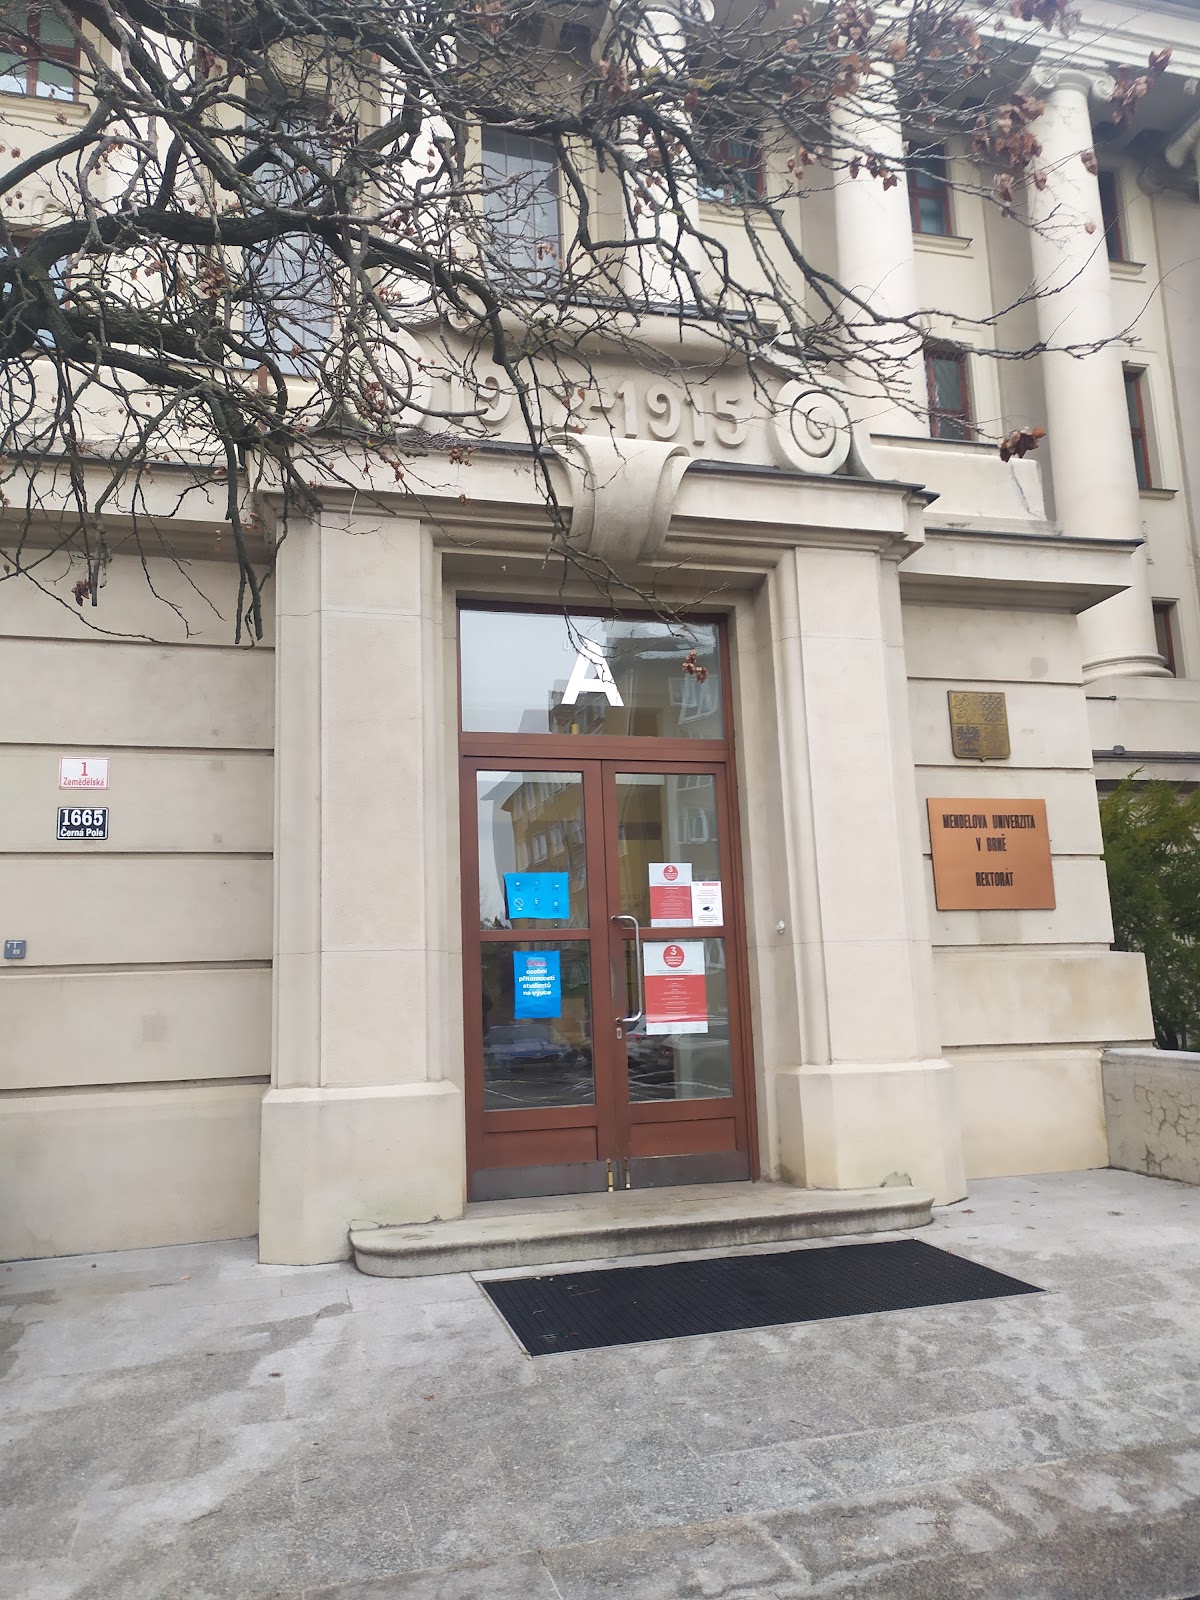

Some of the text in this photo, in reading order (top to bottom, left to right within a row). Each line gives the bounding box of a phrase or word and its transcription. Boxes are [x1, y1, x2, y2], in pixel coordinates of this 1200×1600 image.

[561, 639, 625, 707] A
[81, 762, 88, 776] 1
[63, 777, 105, 786] Zemědělská
[62, 809, 104, 826] 1665
[942, 814, 1036, 829] MENDELOVA UNIVERZITA
[60, 826, 104, 837] Černá Pole
[975, 833, 1007, 852] V BRNĚ
[975, 867, 1014, 887] REKTORÁT
[670, 946, 677, 956] 3
